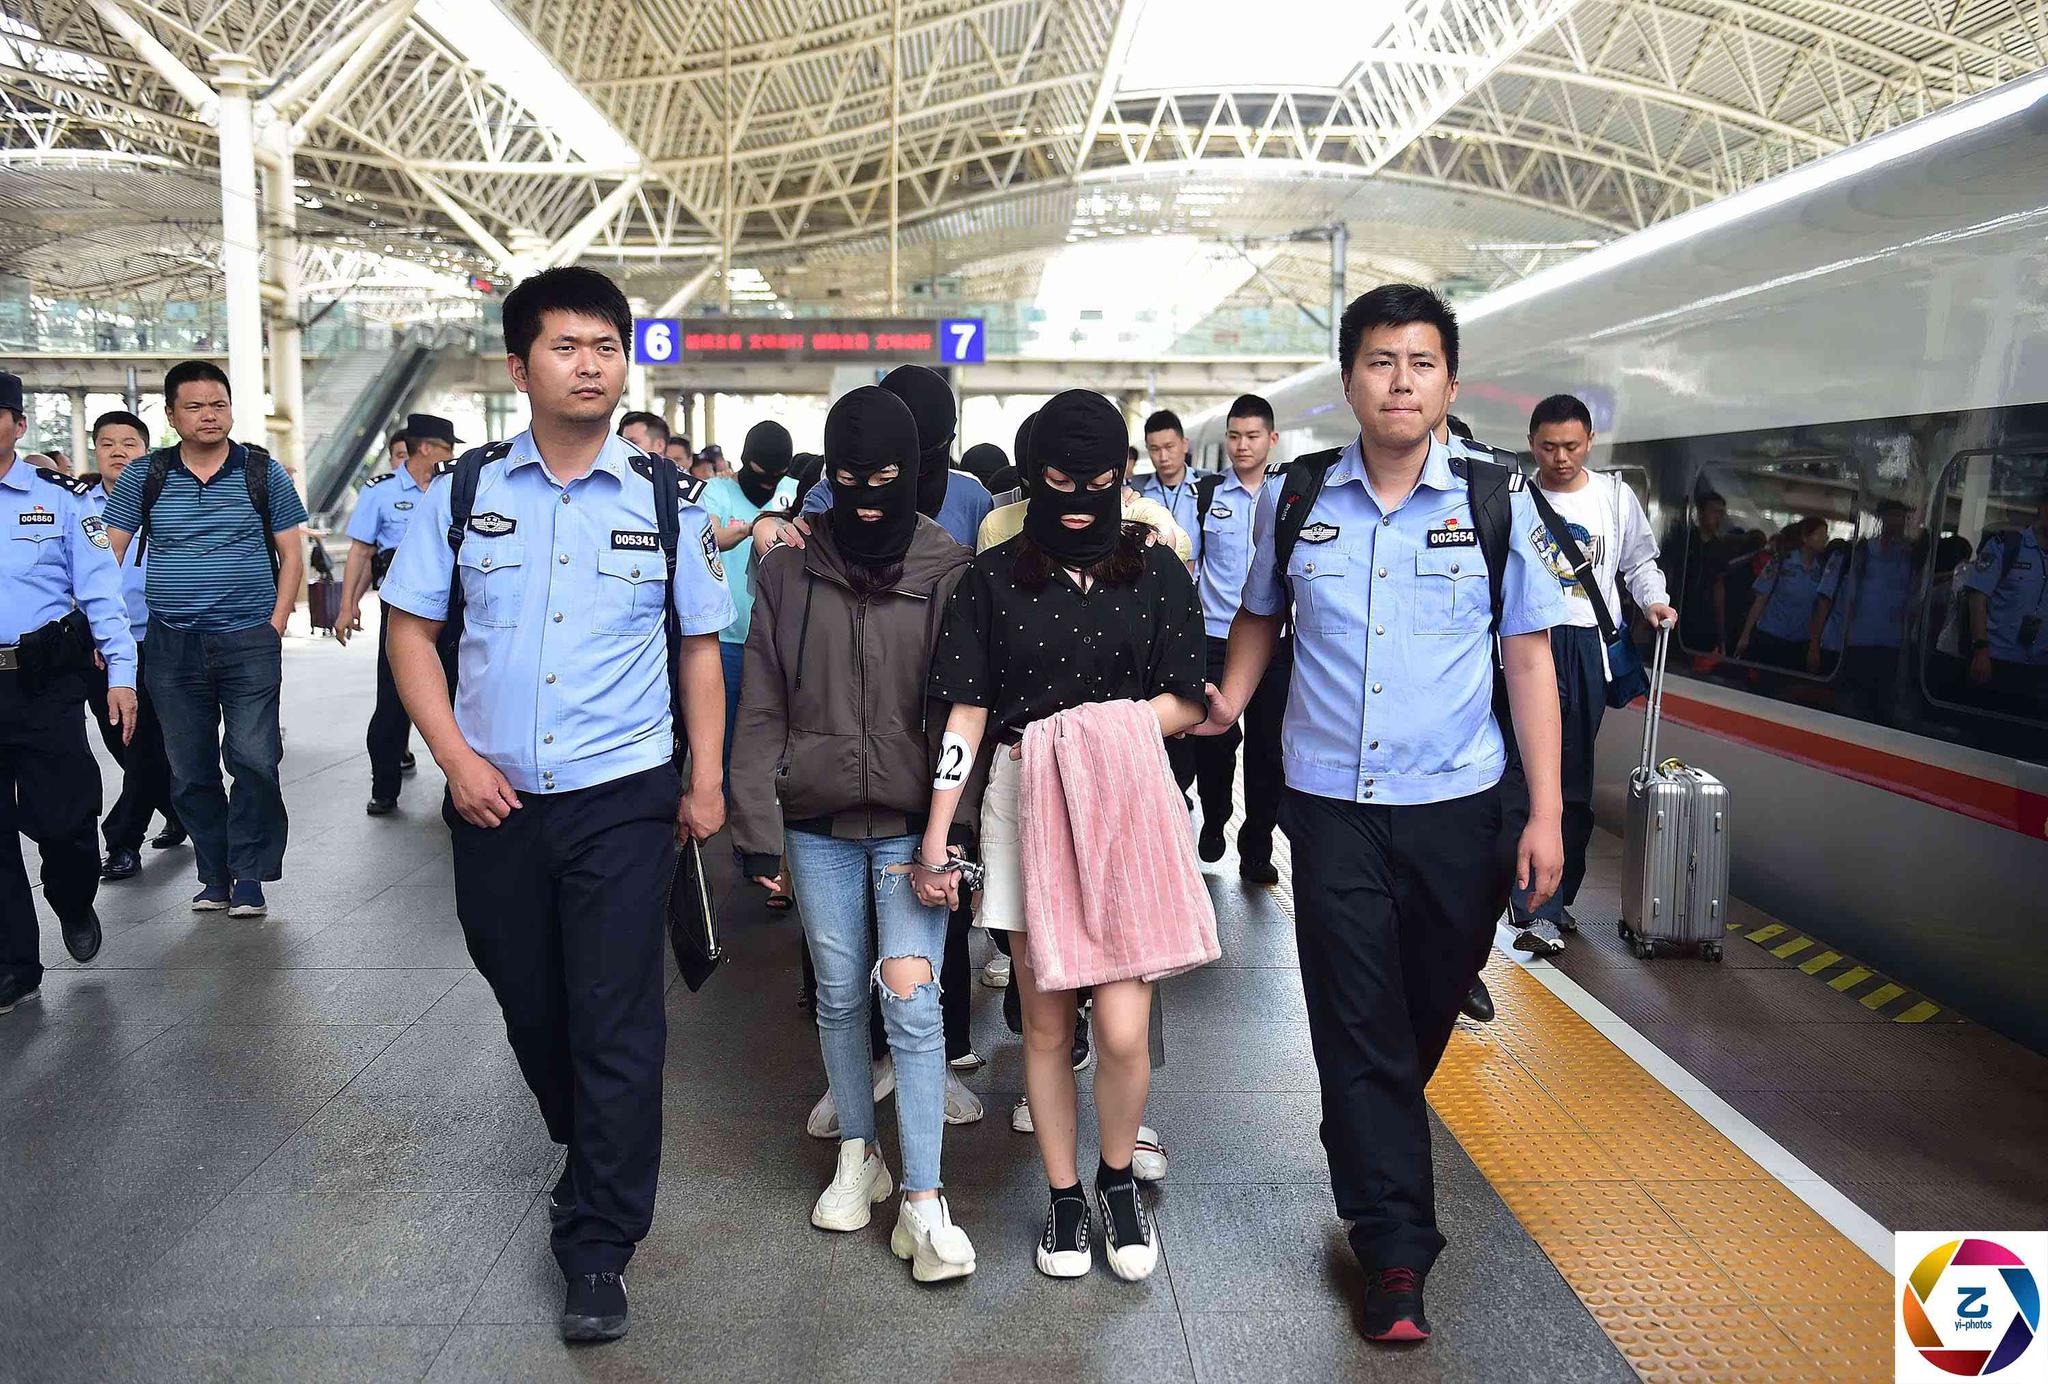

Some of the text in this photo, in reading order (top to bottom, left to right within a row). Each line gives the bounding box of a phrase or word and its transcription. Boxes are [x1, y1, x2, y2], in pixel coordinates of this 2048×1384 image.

[645, 323, 673, 360] 6
[951, 324, 977, 360] 7
[614, 534, 656, 547] 005341
[1430, 531, 1475, 544] 002554
